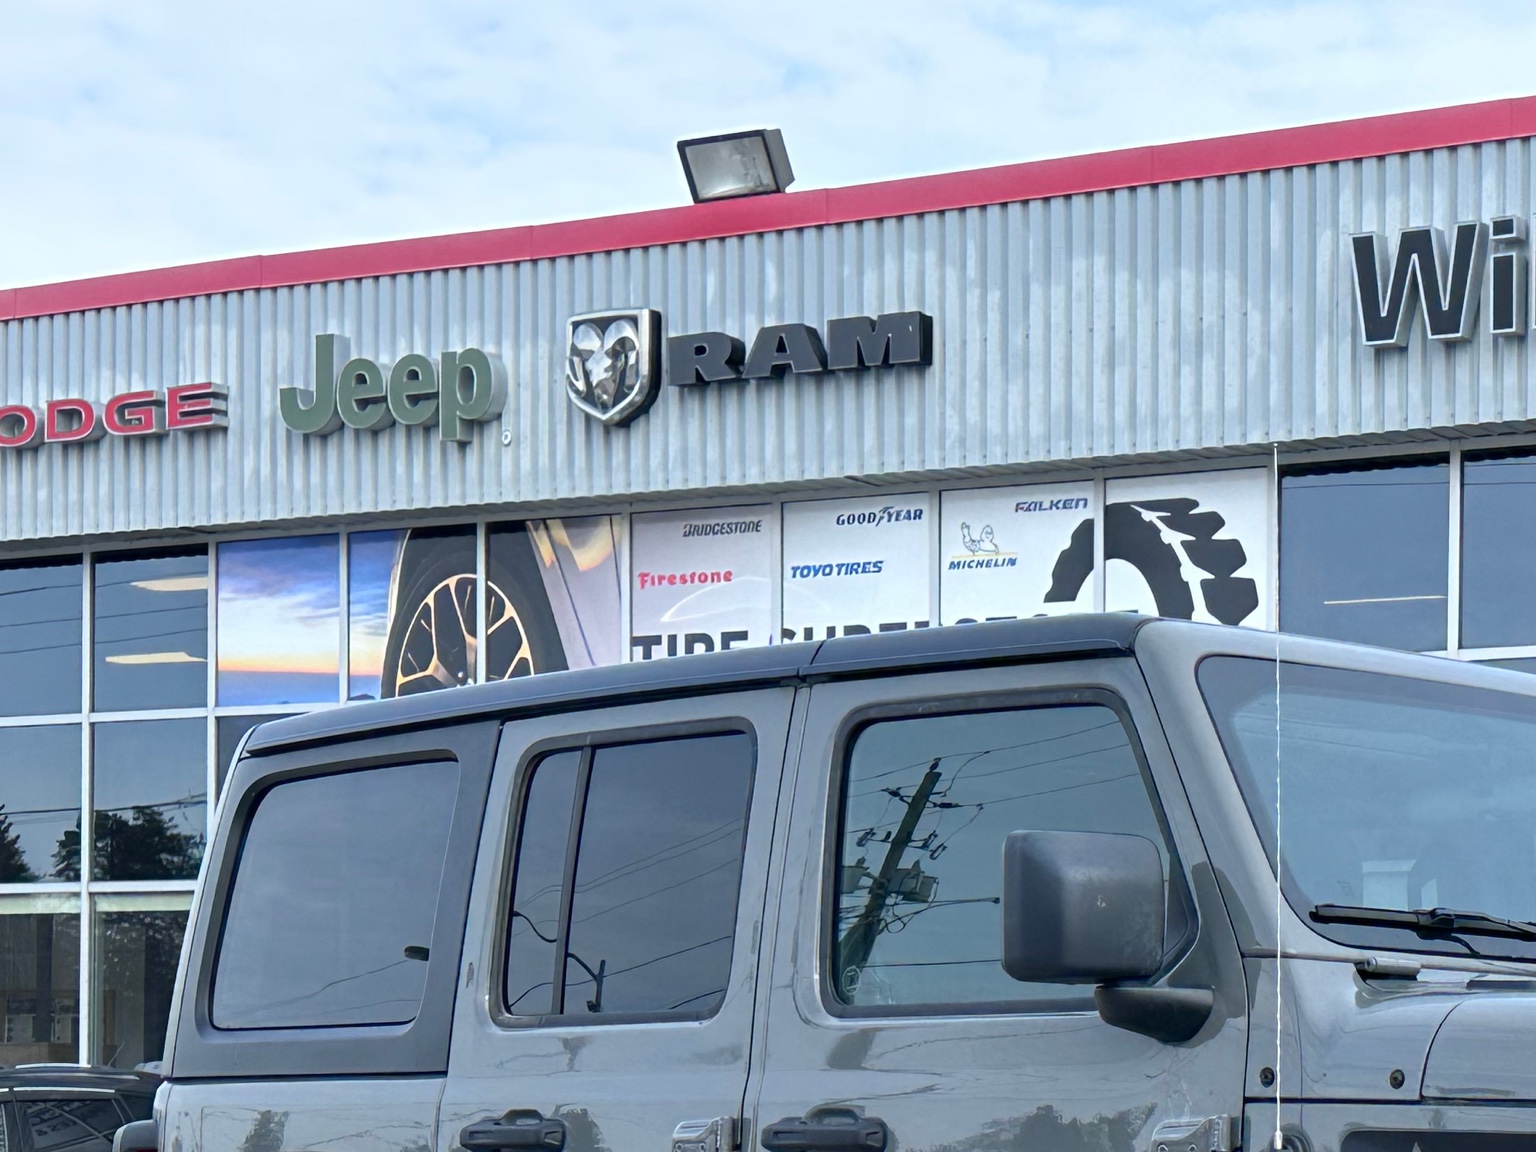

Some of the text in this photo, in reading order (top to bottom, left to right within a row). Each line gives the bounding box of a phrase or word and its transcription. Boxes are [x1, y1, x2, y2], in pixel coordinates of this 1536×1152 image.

[667, 311, 933, 388] RAM
[280, 333, 503, 443] Jeep
[1015, 497, 1089, 513] FALKEN
[836, 506, 924, 527] GOODYEAR
[683, 519, 763, 538] BRIDGESTONE
[791, 560, 885, 579] TOYO TIRES
[948, 557, 1018, 571] MICHELIN
[637, 569, 734, 591] Firestone
